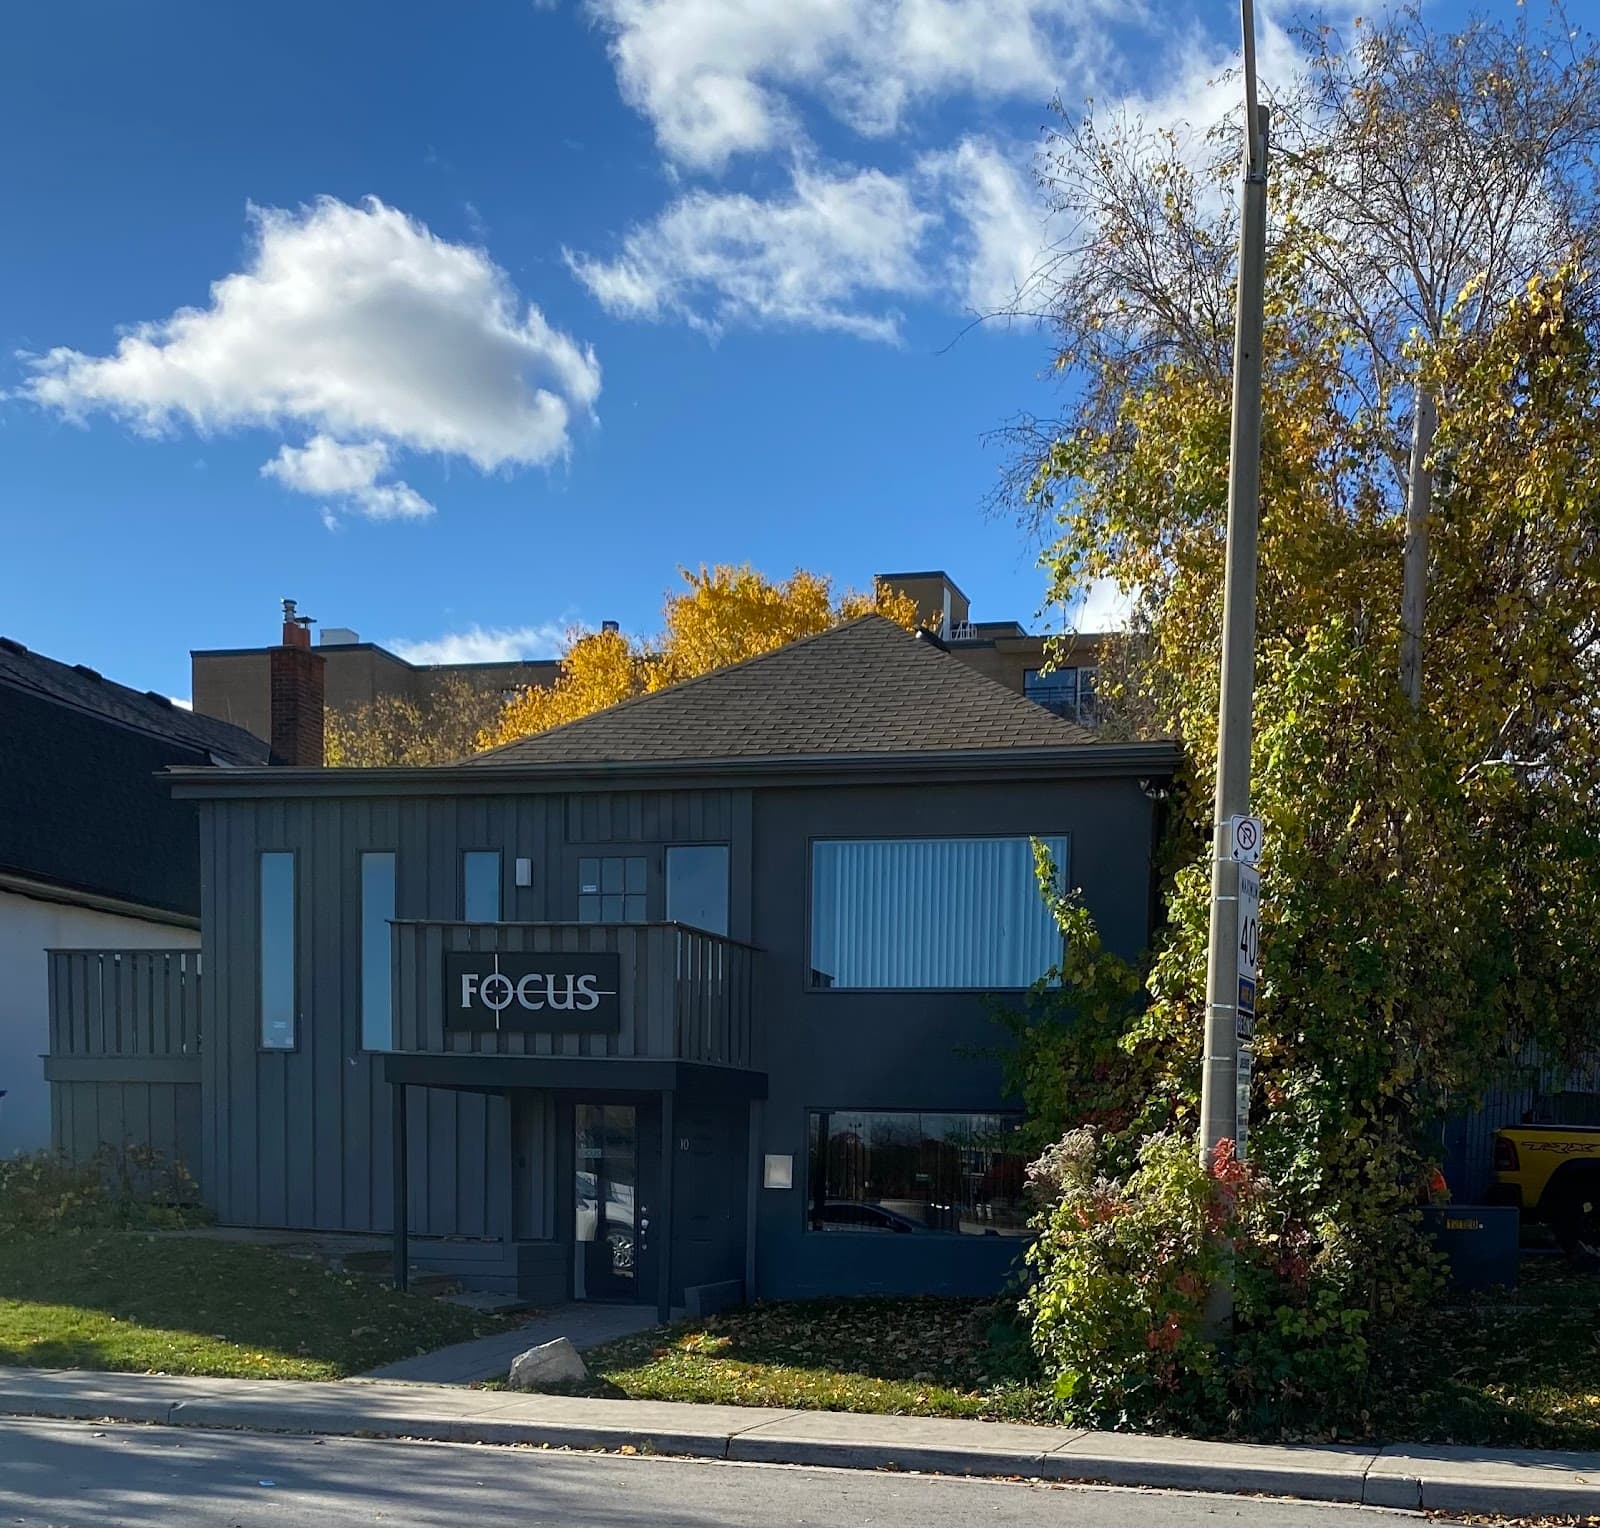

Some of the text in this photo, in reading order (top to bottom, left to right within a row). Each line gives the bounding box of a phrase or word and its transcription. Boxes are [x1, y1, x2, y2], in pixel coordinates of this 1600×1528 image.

[1241, 915, 1256, 967] 40
[461, 973, 600, 1011] FOCUS
[680, 1138, 690, 1151] 10
